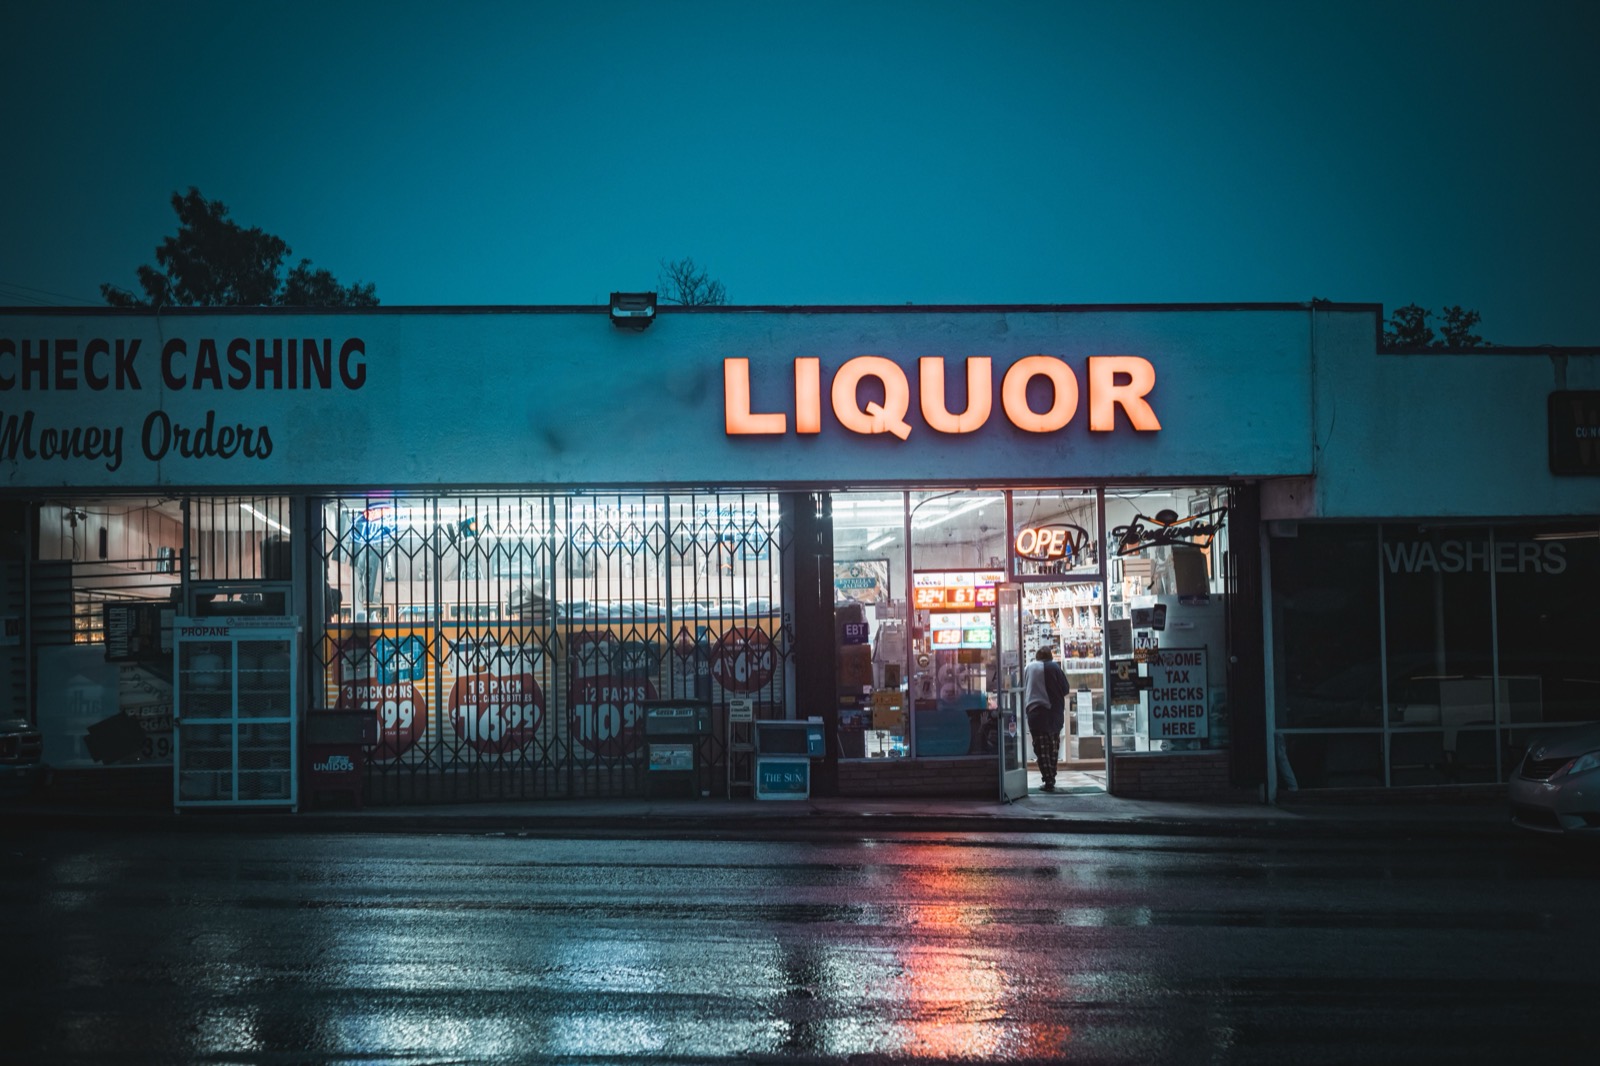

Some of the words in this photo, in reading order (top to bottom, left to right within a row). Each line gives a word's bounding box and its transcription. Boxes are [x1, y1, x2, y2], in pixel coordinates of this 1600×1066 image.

[0, 338, 142, 390] CHECK
[161, 338, 366, 390] CASHING
[723, 355, 1162, 440] LIQUOR
[0, 410, 123, 472] Money
[141, 410, 273, 461] Orders
[1016, 527, 1083, 556] OPEN
[1383, 540, 1567, 574] WASHERS
[917, 590, 944, 603] 324
[181, 627, 230, 637] PROPANE
[846, 624, 865, 635] EBT
[1135, 638, 1158, 649] RAP
[1153, 653, 1202, 666] NOME
[1165, 671, 1190, 683] TAX
[356, 685, 383, 698] PACK
[385, 684, 413, 698] CANS
[469, 680, 485, 694] 18
[490, 680, 522, 694] PACK
[1152, 688, 1204, 701] CHECKS
[1153, 705, 1204, 718] CASHED
[1162, 722, 1196, 735] HERE
[313, 762, 354, 771] UNIDOS
[765, 773, 782, 782] THE
[784, 772, 802, 782] SUN
